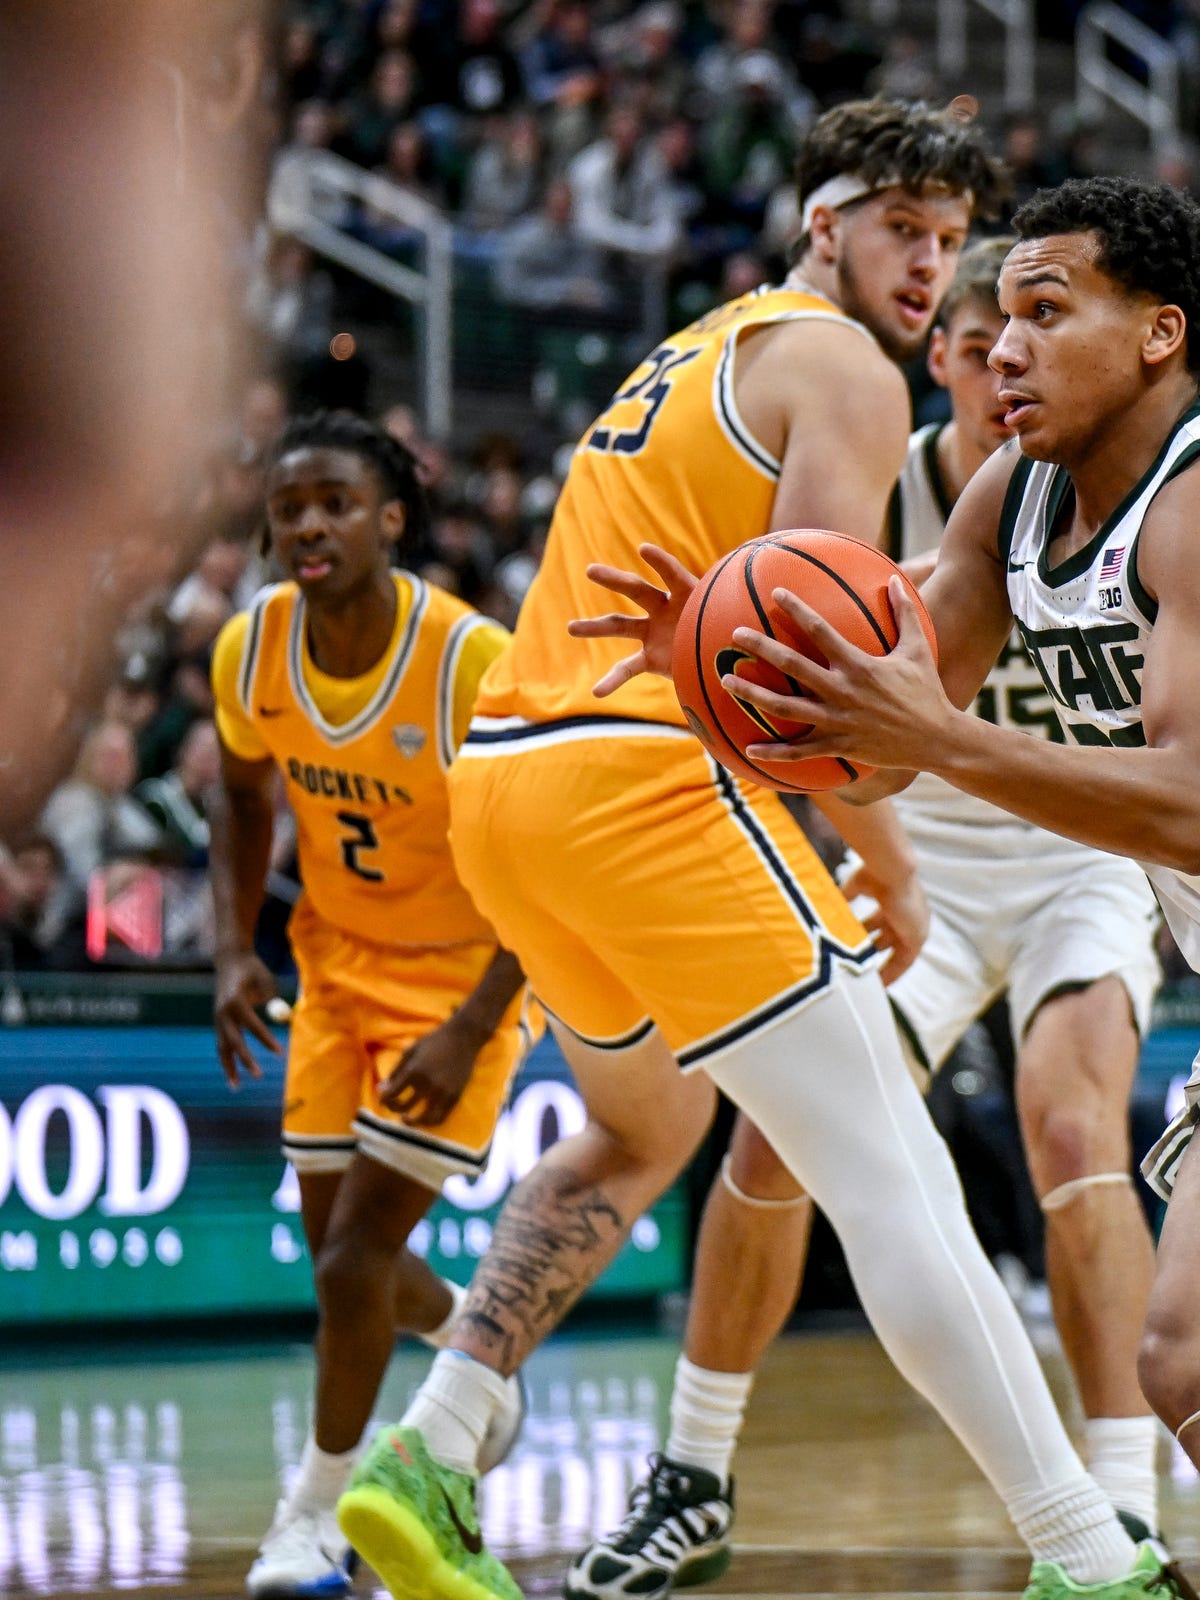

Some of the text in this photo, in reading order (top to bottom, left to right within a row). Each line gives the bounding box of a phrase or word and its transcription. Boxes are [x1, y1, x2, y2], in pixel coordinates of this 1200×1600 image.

[286, 757, 415, 806] ROCKETS
[337, 811, 386, 882] 2
[0, 1083, 191, 1221] OD
